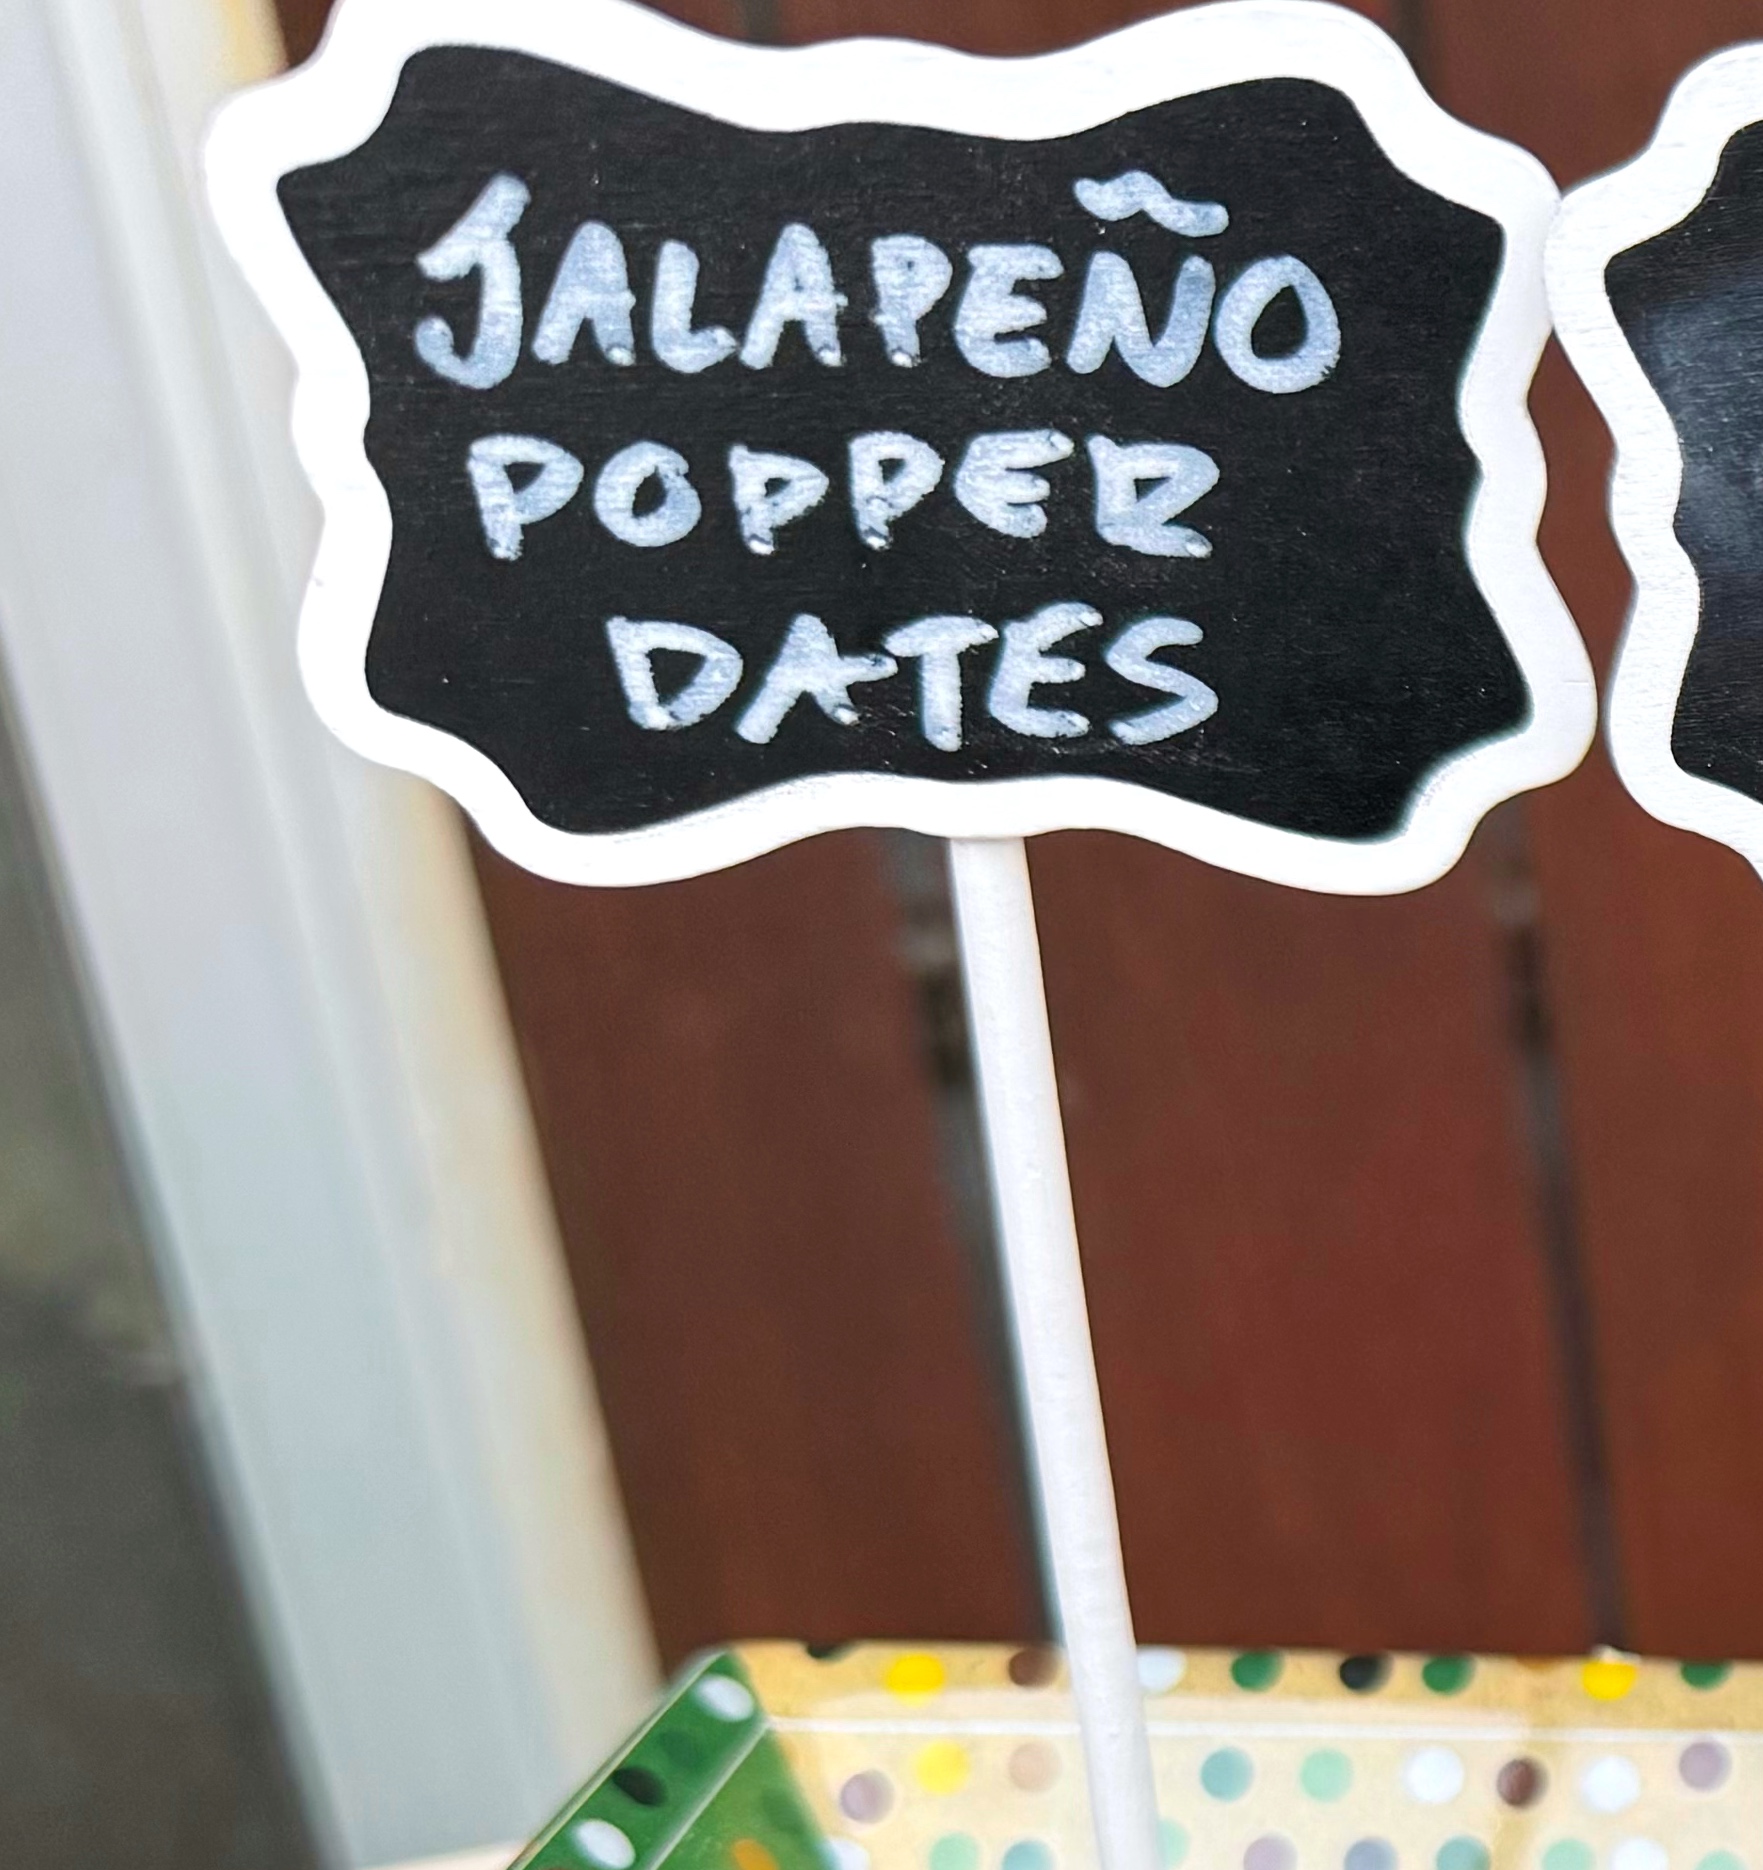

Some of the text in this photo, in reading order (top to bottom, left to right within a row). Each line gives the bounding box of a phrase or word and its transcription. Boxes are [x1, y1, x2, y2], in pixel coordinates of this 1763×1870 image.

[416, 171, 1342, 392] JALAPEÑO
[467, 430, 1219, 560] POPPER
[607, 604, 1218, 751] DATES
